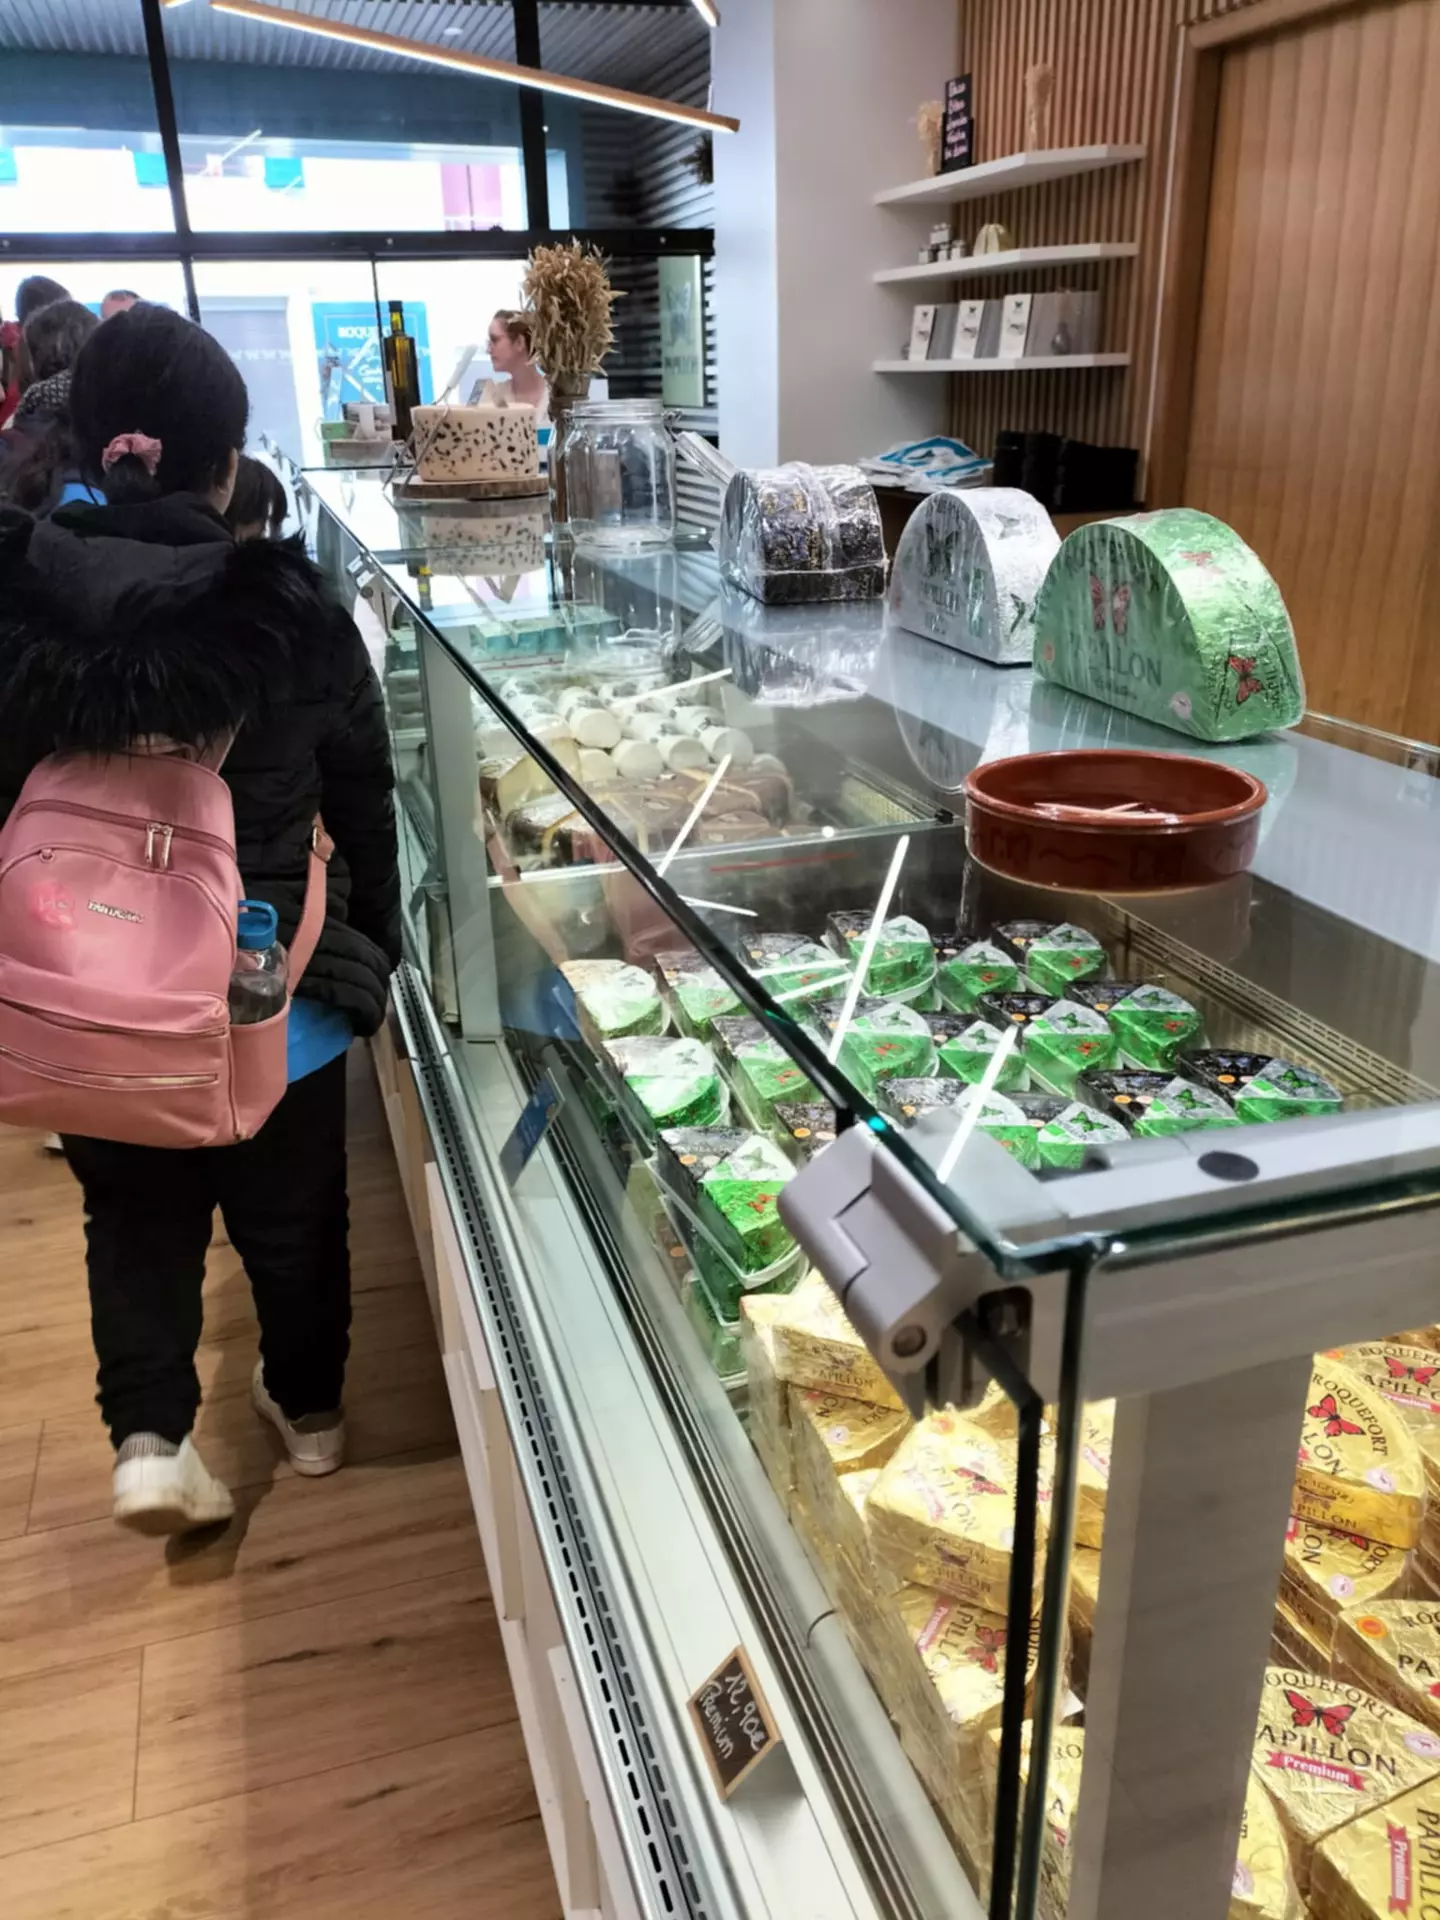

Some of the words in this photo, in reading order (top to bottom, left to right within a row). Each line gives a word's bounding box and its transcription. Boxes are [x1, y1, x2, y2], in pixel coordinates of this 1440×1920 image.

[1312, 1373, 1389, 1457] ROQUEFORT
[1265, 1671, 1394, 1722] OQUEFORT
[1257, 1724, 1397, 1777] APILLON
[1283, 1754, 1350, 1784] Premium
